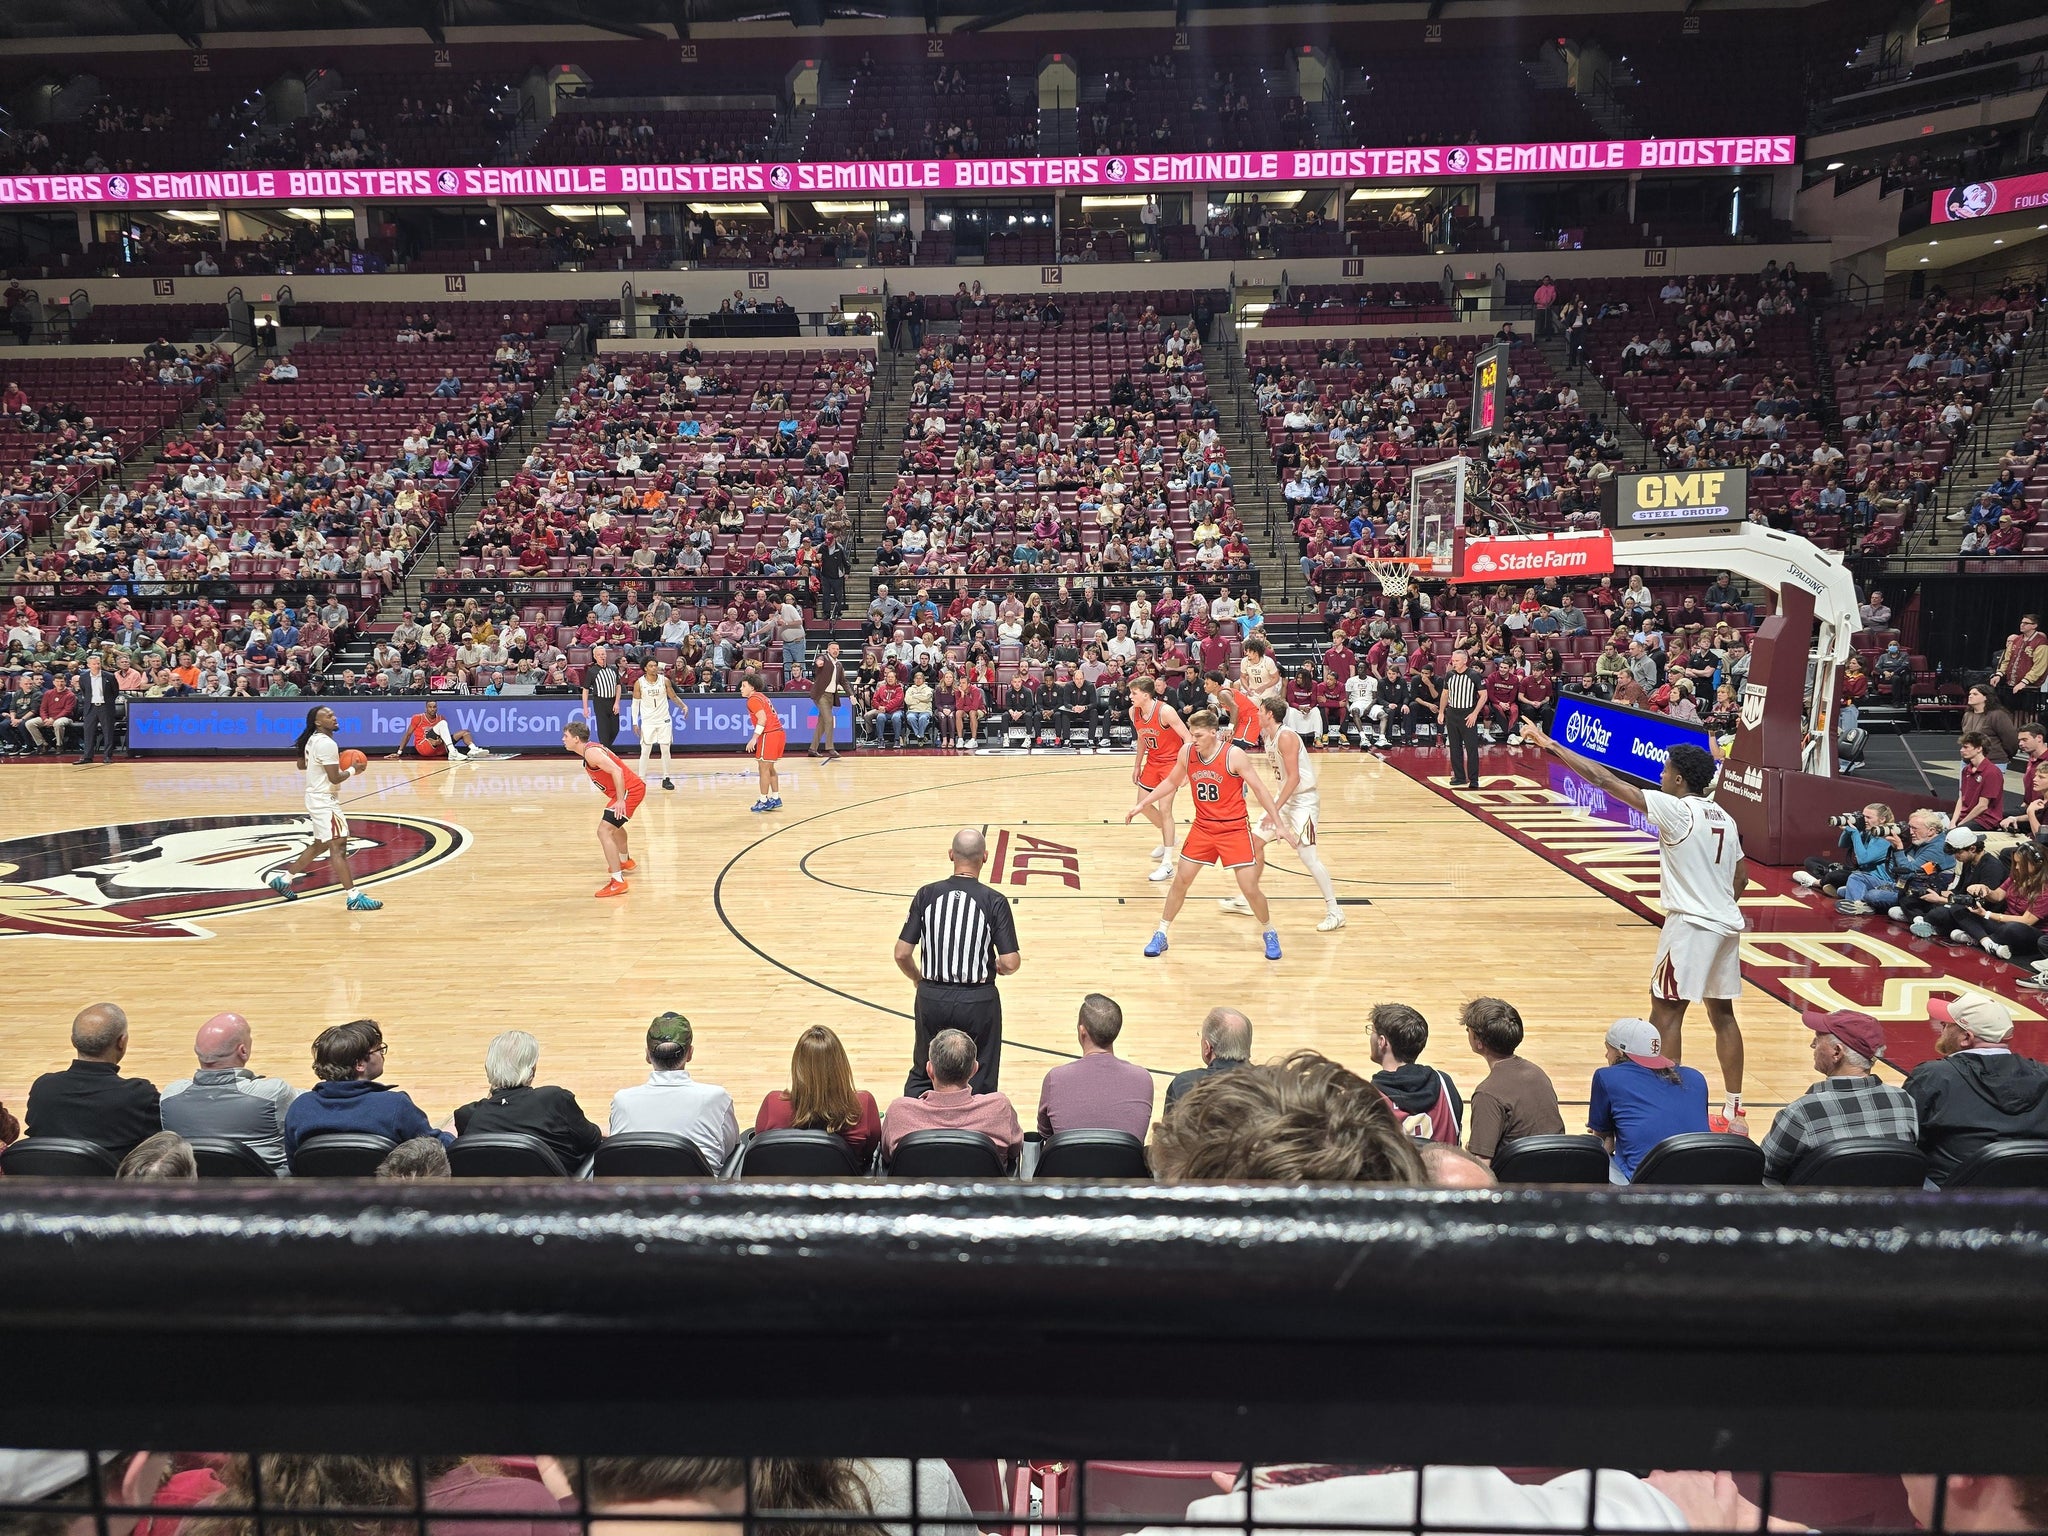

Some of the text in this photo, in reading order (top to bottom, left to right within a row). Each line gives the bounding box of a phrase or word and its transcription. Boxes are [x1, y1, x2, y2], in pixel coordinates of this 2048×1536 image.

[1426, 25, 1441, 37] 210
[928, 40, 944, 52] 212
[1175, 33, 1187, 45] 211
[434, 50, 450, 62] 214
[681, 45, 697, 57] 213
[193, 54, 209, 66] 215
[135, 172, 275, 200] SEMINOLE
[289, 170, 431, 196] BOOSTERS
[465, 167, 606, 194] SEMINOLE
[621, 165, 764, 192] BOOSTERS
[797, 162, 940, 190] SEMINOLE
[954, 158, 1099, 187] BOOSTERS
[1132, 153, 1278, 182] SEMINOLE
[1293, 149, 1441, 178] BOOSTERS
[1475, 143, 1625, 172] SEMINOLE
[1639, 137, 1791, 167] BOOSTERS
[2014, 193, 2048, 209] FOULS
[1648, 251, 1664, 265] 110
[1045, 268, 1059, 282] 112
[1348, 260, 1359, 275] 111
[156, 280, 171, 295] 115
[448, 276, 463, 291] 114
[751, 273, 766, 287] 113
[1637, 472, 1725, 509] GMF
[1639, 507, 1723, 519] STEEL GROUP
[1787, 564, 1825, 595] SPALDING
[1254, 676, 1262, 684] 10
[1360, 689, 1366, 697] 12
[135, 710, 249, 736] victories
[456, 707, 558, 733] Wolfson
[1581, 714, 1612, 747] VyStar
[1631, 737, 1645, 757] Do
[1725, 768, 1743, 783] Wolfson
[1197, 782, 1219, 801] 28
[1743, 787, 1763, 803] Hospital
[1711, 827, 1725, 864] 7
[1010, 833, 1081, 891] ACC
